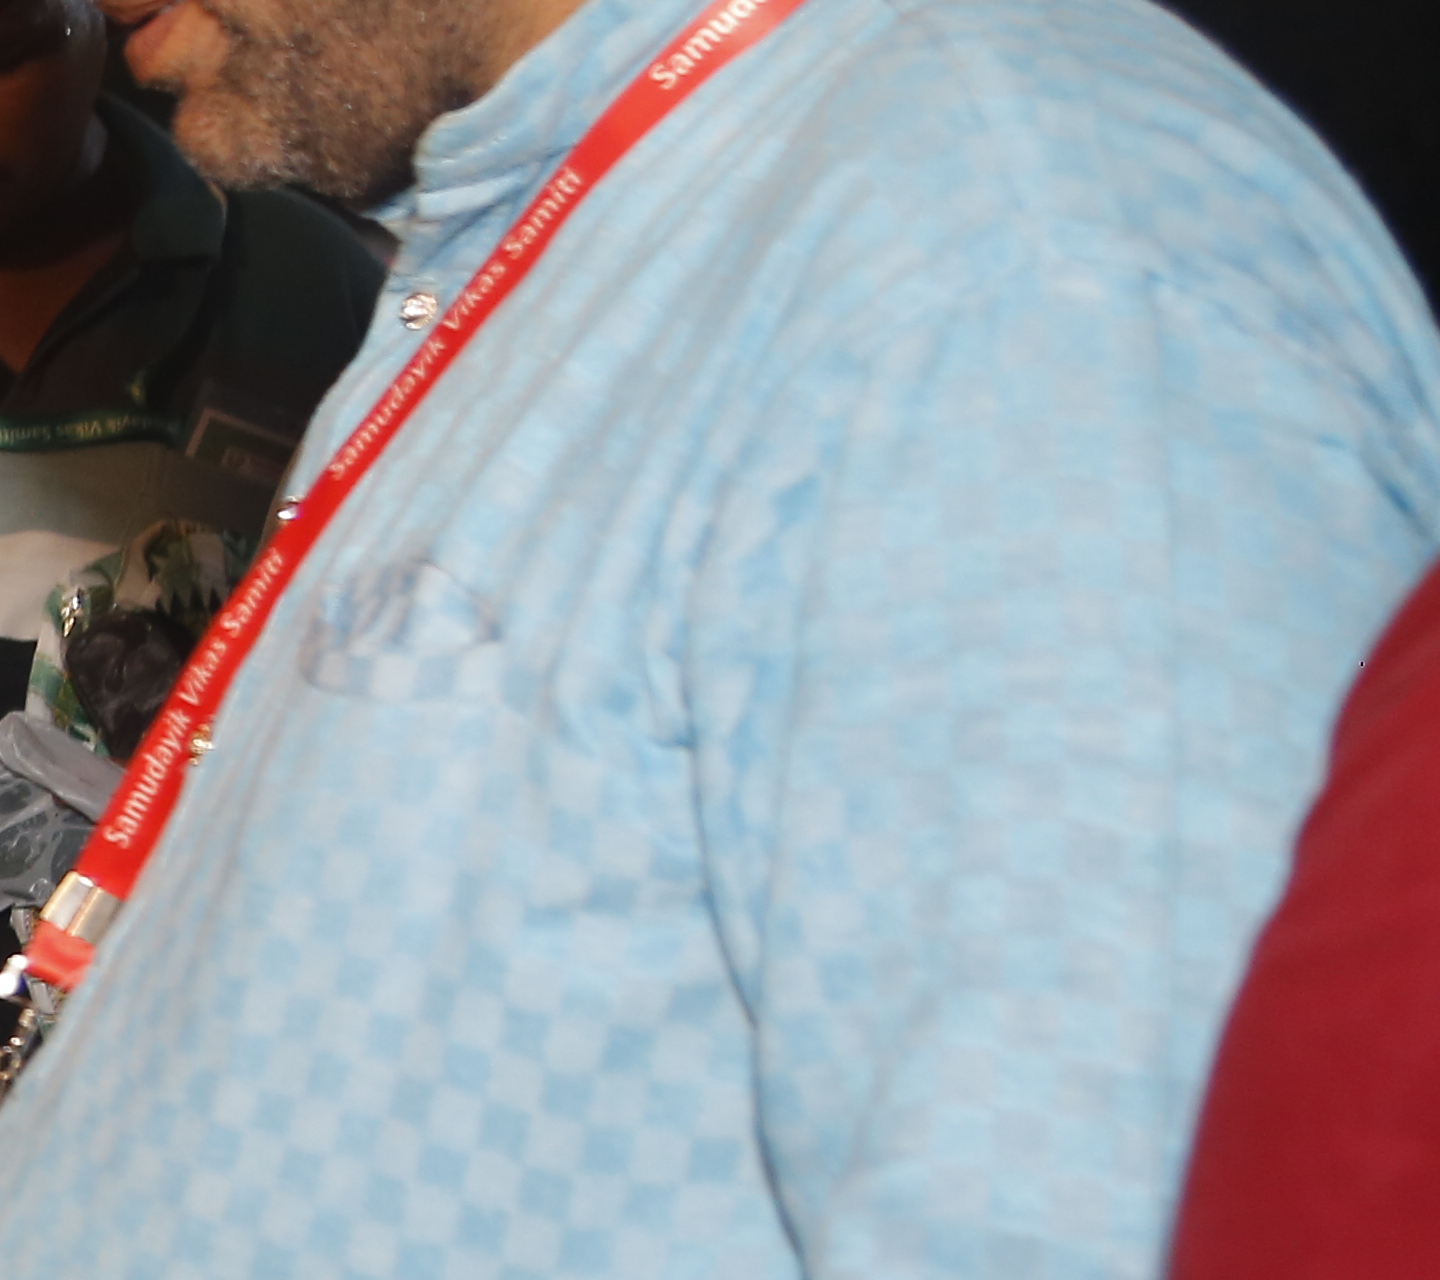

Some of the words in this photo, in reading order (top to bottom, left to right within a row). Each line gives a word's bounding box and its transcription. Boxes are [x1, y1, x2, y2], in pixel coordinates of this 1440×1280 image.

[331, 337, 446, 480] Samudayik
[443, 264, 506, 331] Vikas
[504, 166, 581, 260] Samiti
[103, 708, 192, 850] Samudayik
[177, 641, 227, 707] Vikas
[219, 546, 285, 638] Samiti
